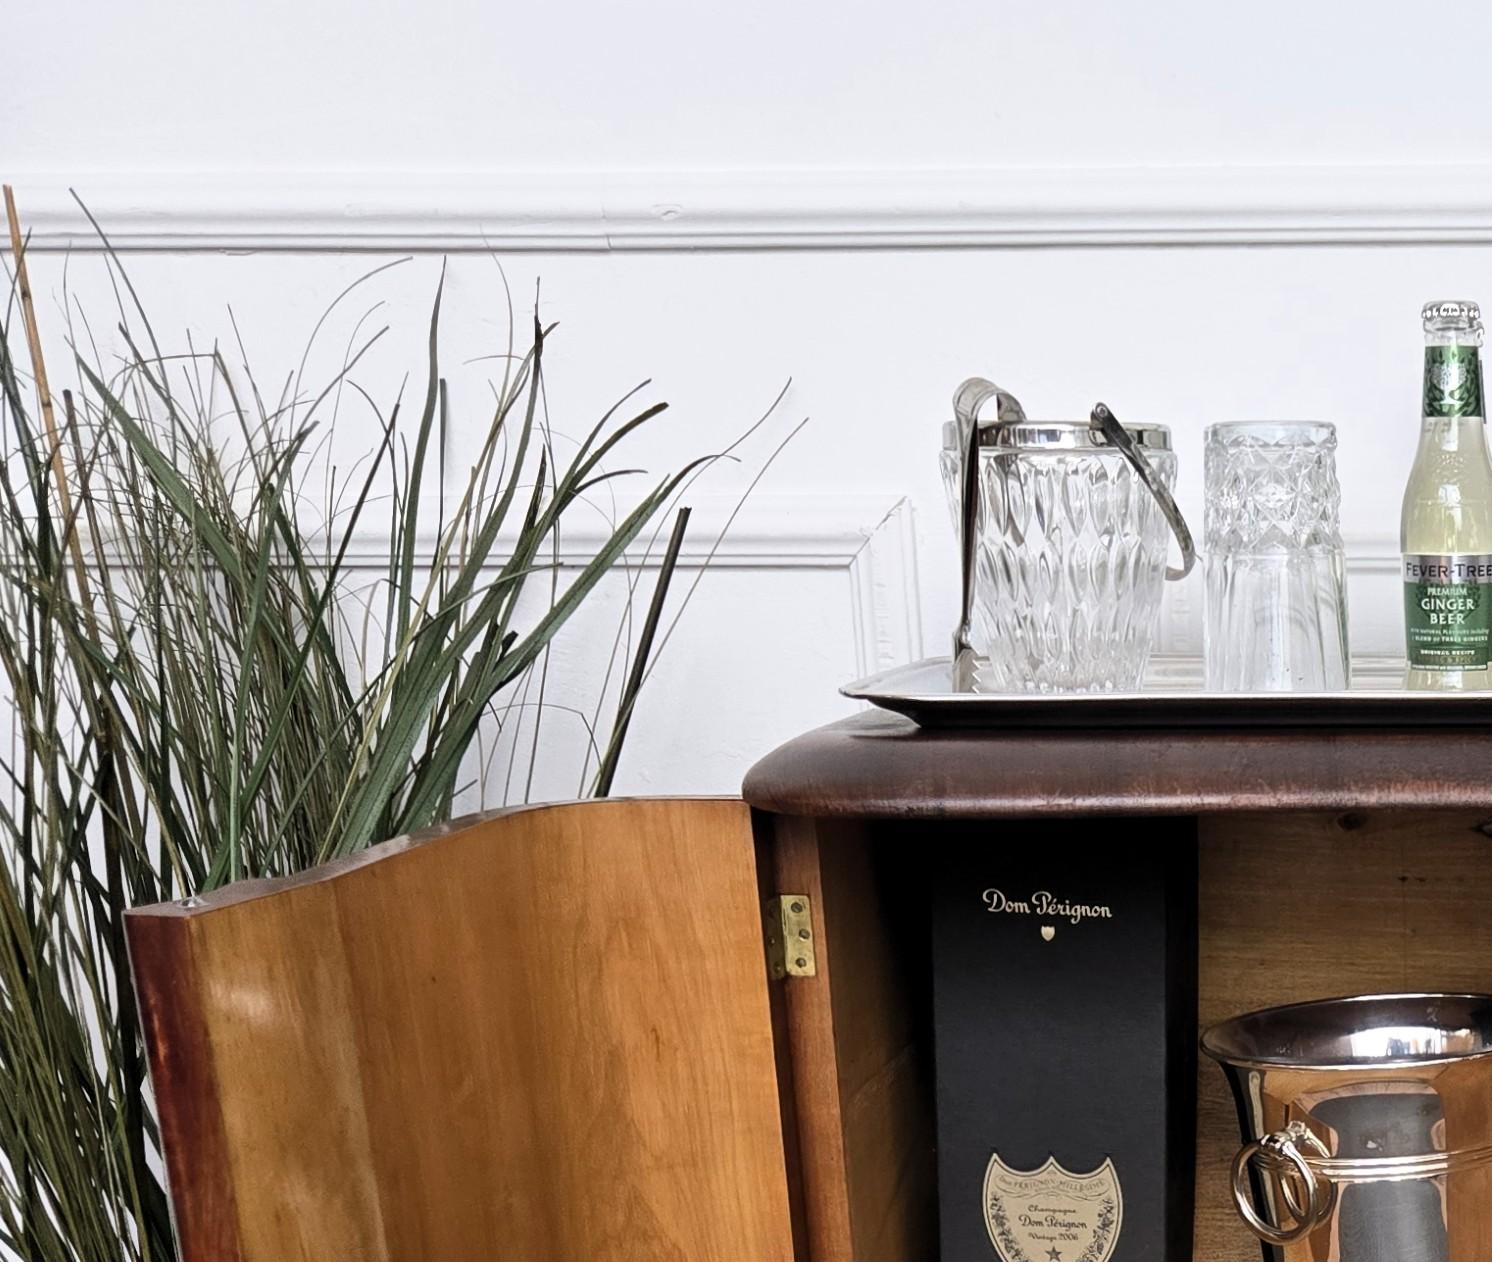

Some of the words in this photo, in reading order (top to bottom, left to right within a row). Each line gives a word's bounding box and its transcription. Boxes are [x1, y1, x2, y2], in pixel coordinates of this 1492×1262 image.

[1406, 563, 1492, 577] FEVER-TREE
[1427, 587, 1467, 596] PREMIUM
[1421, 598, 1475, 610] GINGER
[1430, 613, 1465, 625] BEER
[982, 888, 1030, 914] Dom
[1031, 891, 1113, 924] Pérignon
[1018, 1214, 1044, 1228] Dom
